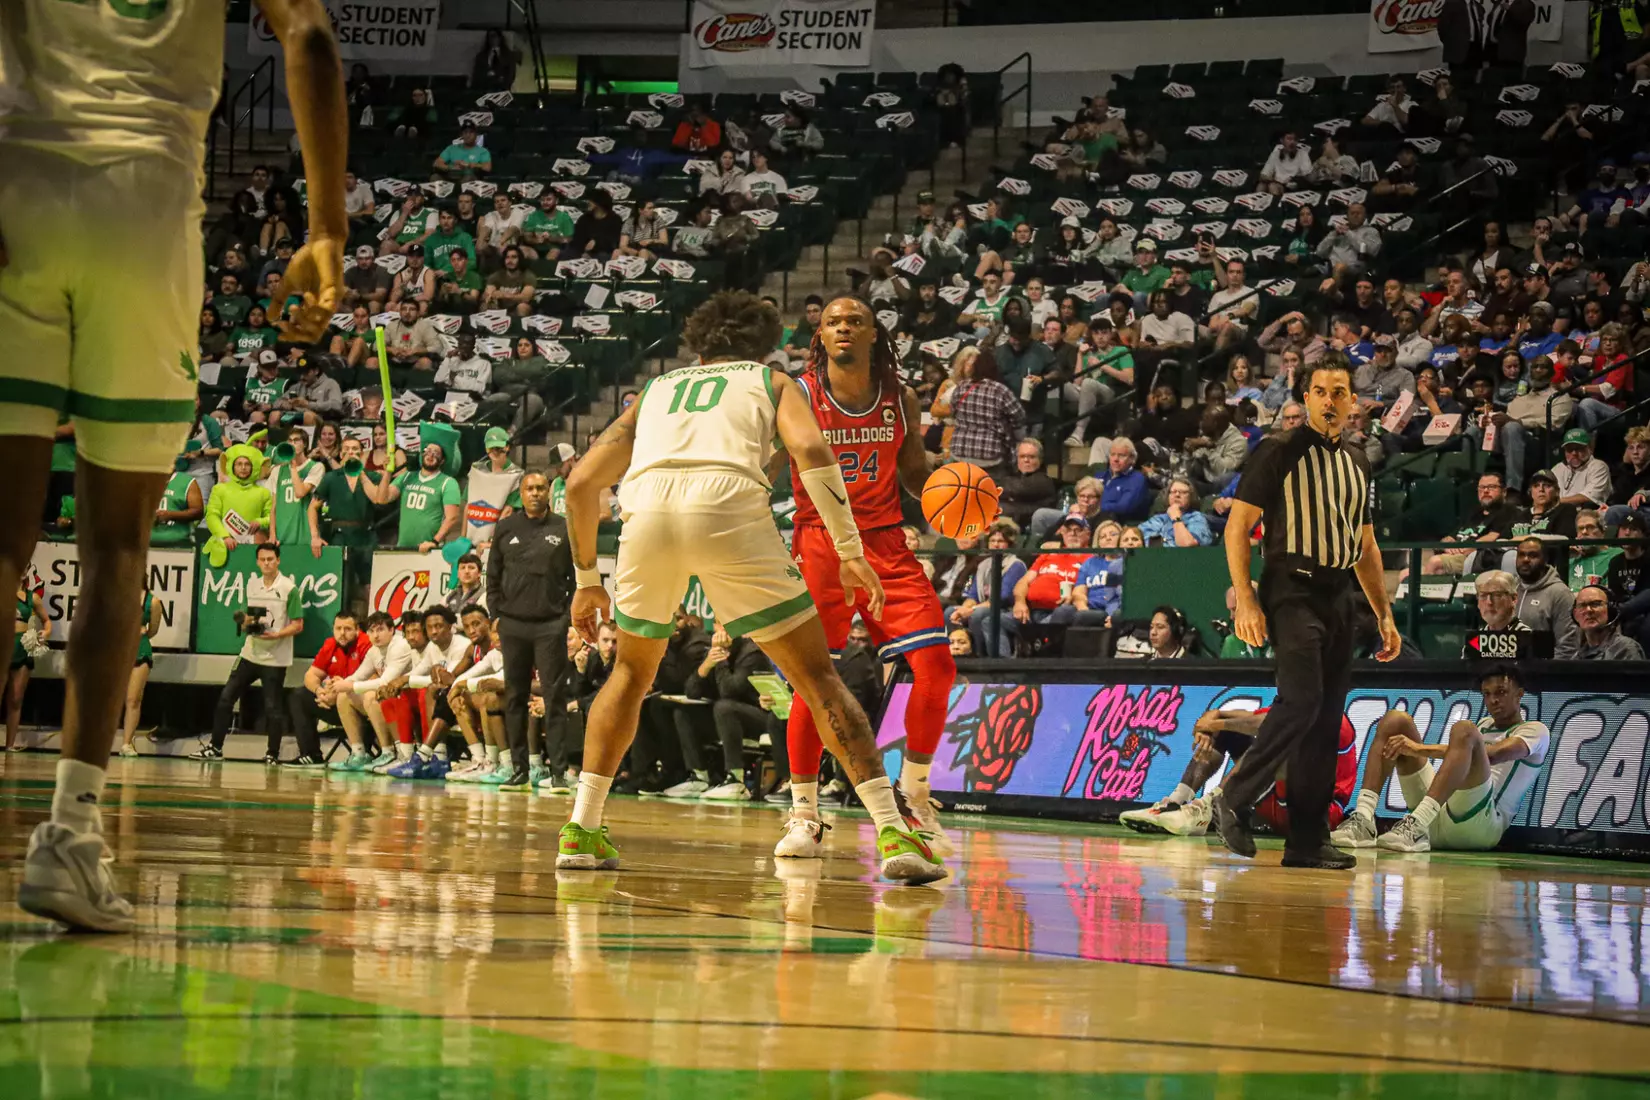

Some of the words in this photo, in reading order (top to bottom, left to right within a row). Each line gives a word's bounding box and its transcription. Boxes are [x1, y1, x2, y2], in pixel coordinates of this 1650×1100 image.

[340, 4, 436, 25] STUDENT
[778, 8, 873, 28] STUDENT
[339, 26, 427, 46] SECTION
[700, 13, 776, 50] Cane's
[776, 31, 862, 50] SECTION
[657, 363, 759, 382] HUNTSBERRY
[667, 375, 729, 415] 10
[822, 426, 895, 446] BULLDOGS
[838, 449, 880, 484] 24
[406, 492, 427, 510] 00
[50, 559, 188, 593] STNT
[201, 568, 339, 609] MACS
[1479, 633, 1518, 654] POSS
[1481, 651, 1517, 659] DAKTRONICS
[1062, 684, 1183, 797] Rosa's
[1083, 747, 1150, 802] Café
[1538, 709, 1650, 830] FA
